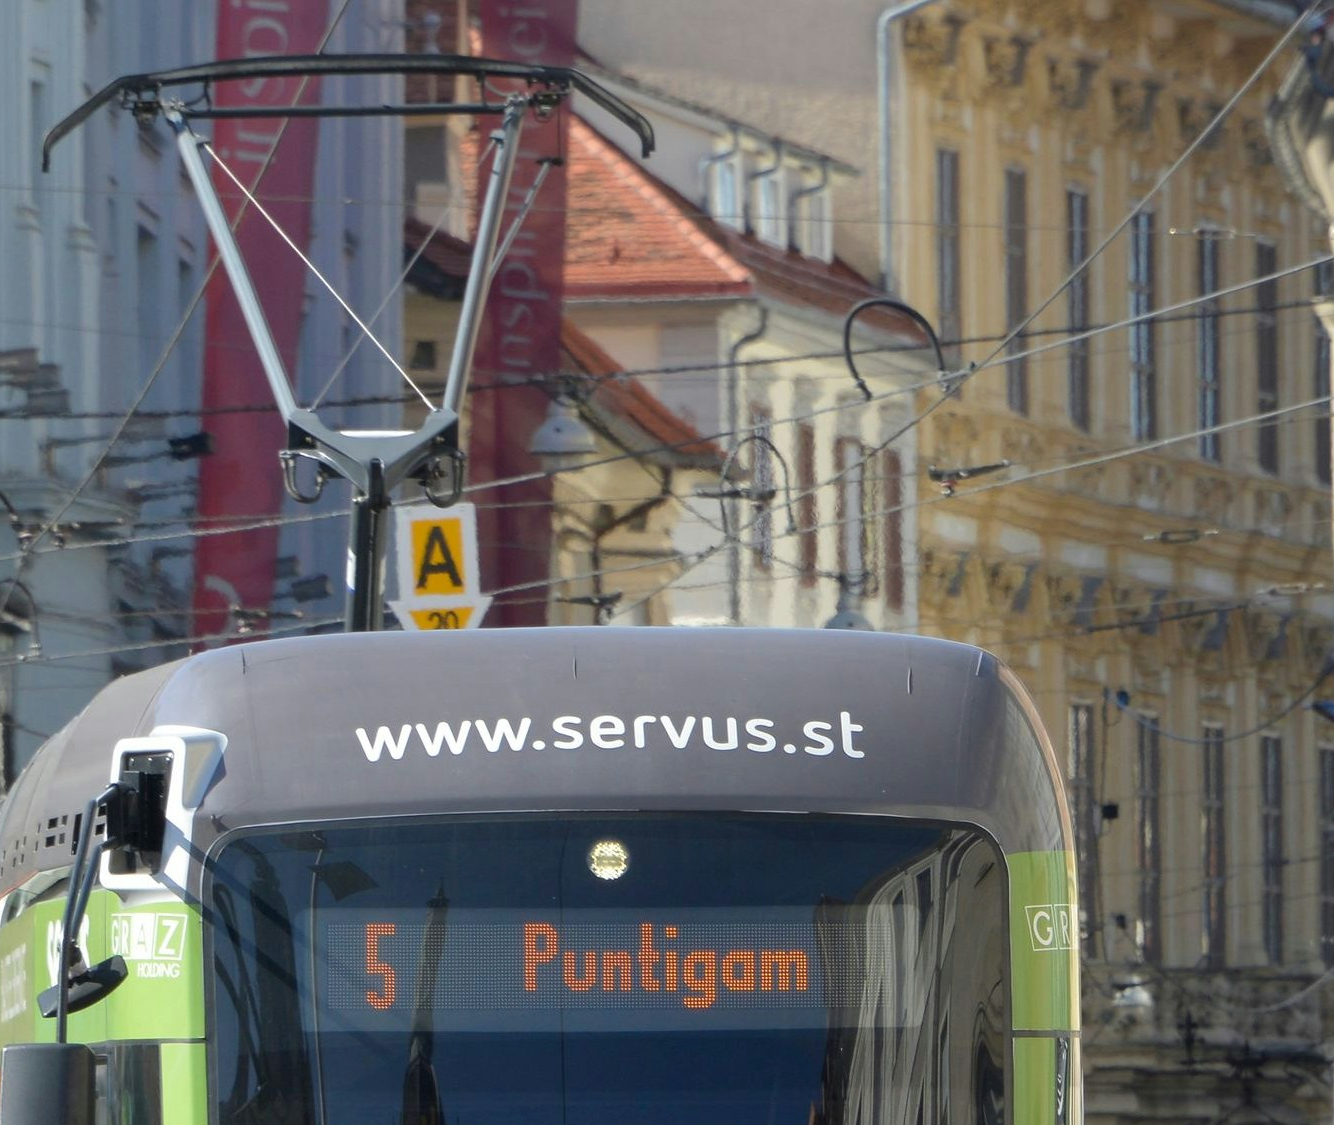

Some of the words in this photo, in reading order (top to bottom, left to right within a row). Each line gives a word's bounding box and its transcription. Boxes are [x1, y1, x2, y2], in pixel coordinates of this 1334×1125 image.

[415, 525, 464, 589] A
[355, 710, 866, 762] www.servus.st
[137, 963, 180, 979] HOLDING
[365, 923, 396, 1011] 5
[522, 922, 810, 1010] Puntigam
